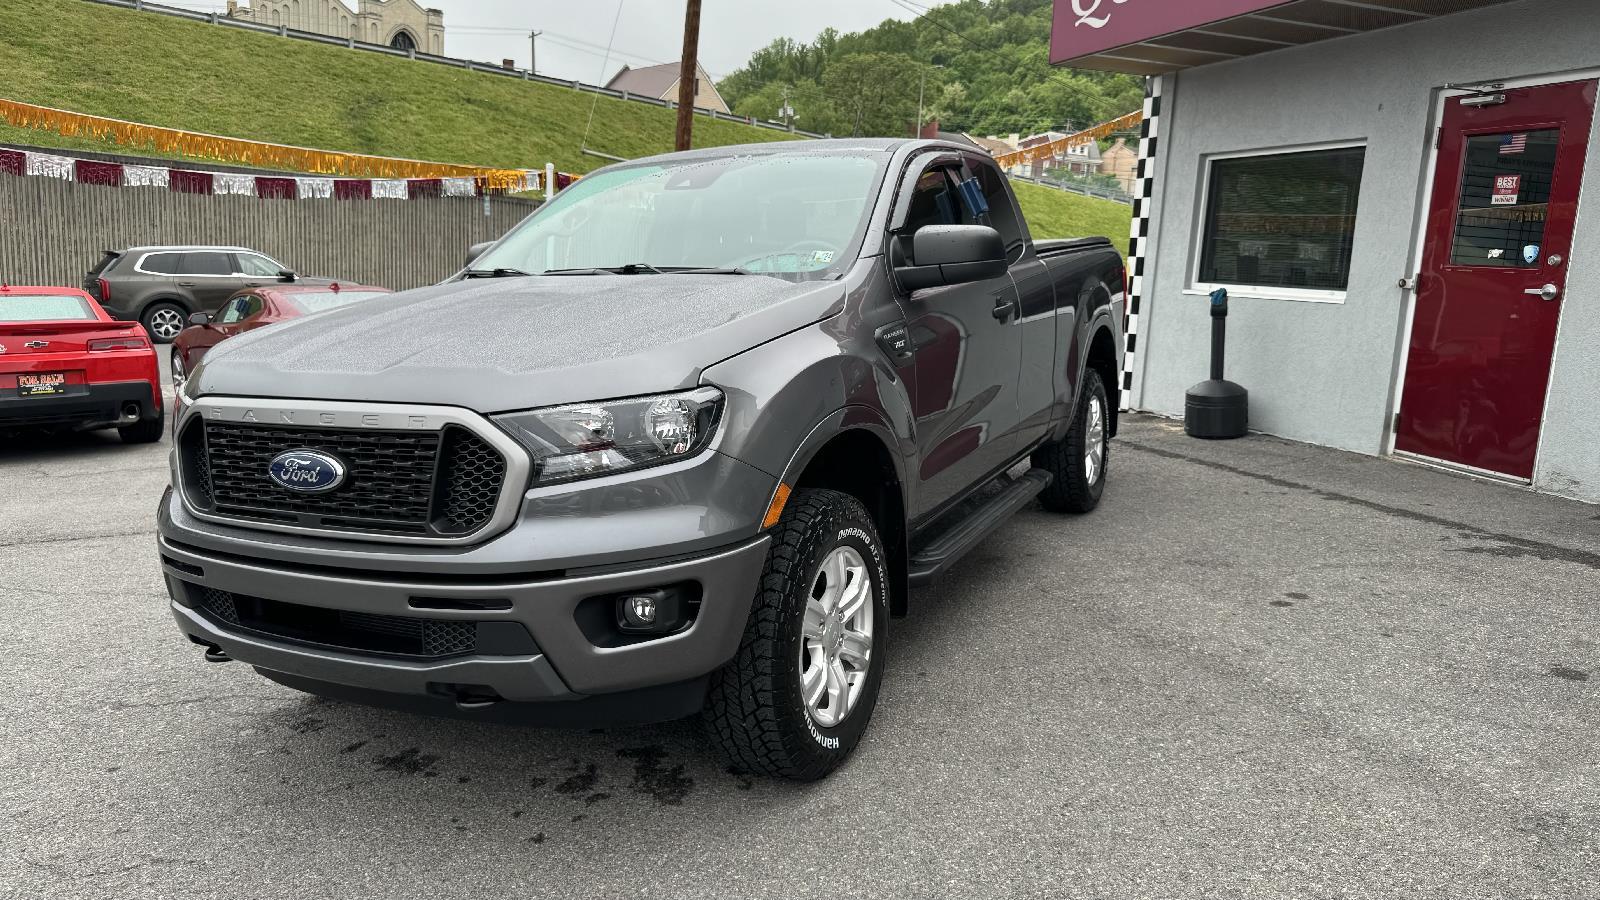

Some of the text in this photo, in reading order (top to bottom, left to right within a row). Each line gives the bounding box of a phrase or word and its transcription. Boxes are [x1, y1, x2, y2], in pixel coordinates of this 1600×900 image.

[1497, 176, 1518, 187] BEST
[883, 329, 905, 339] RANGER
[40, 373, 65, 384] SALE
[209, 407, 427, 429] RANGER
[280, 457, 320, 484] Ford
